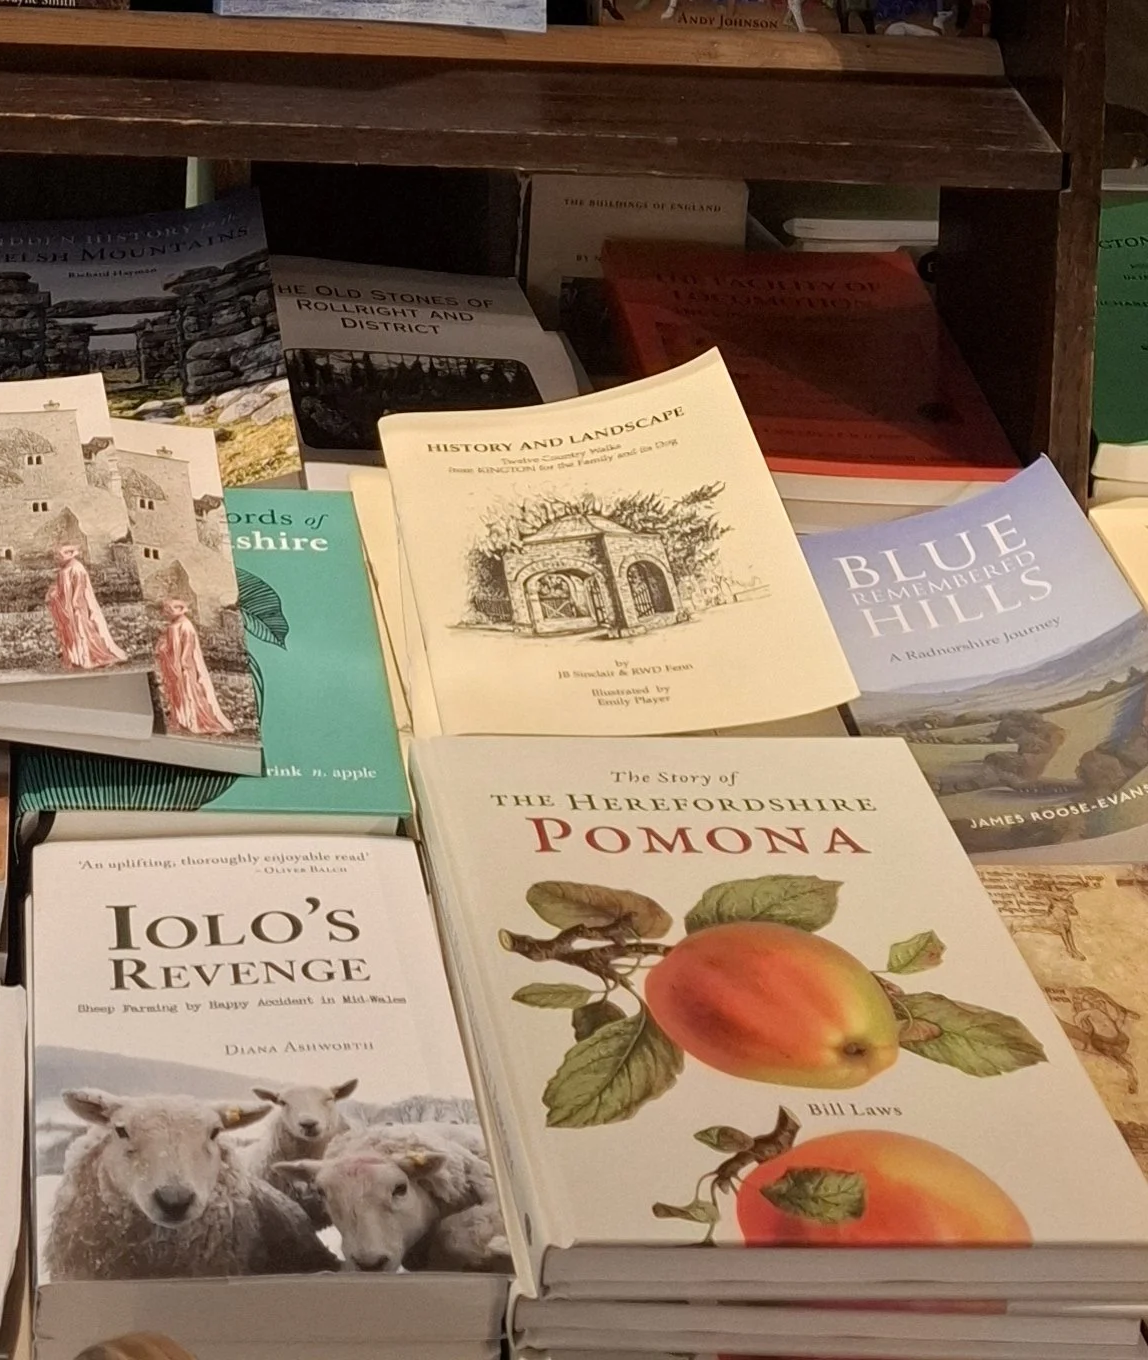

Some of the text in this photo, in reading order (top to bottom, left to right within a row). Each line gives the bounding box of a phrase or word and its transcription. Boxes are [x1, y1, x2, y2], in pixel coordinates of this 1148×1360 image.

[563, 197, 722, 213] THE BUILDINGS OF ENGLAND
[273, 283, 496, 310] HE OLD STONES OF
[294, 297, 475, 324] ROLLRIGHT AND
[340, 315, 442, 336] DISTRICT
[426, 405, 687, 455] HISTORY AND LANDSCAPE
[304, 511, 328, 528] of
[832, 513, 1028, 591] BLUE
[852, 549, 1037, 606] REMEMBERED
[859, 565, 1053, 639] HILLS
[332, 764, 377, 780] apple
[490, 791, 879, 813] THE HEREFORDSHIRE
[524, 816, 873, 856] POMONA
[108, 957, 372, 992] REVENGE
[224, 1040, 375, 1057] DIANA ASHWORTH
[808, 1102, 903, 1118] Bill Laws
